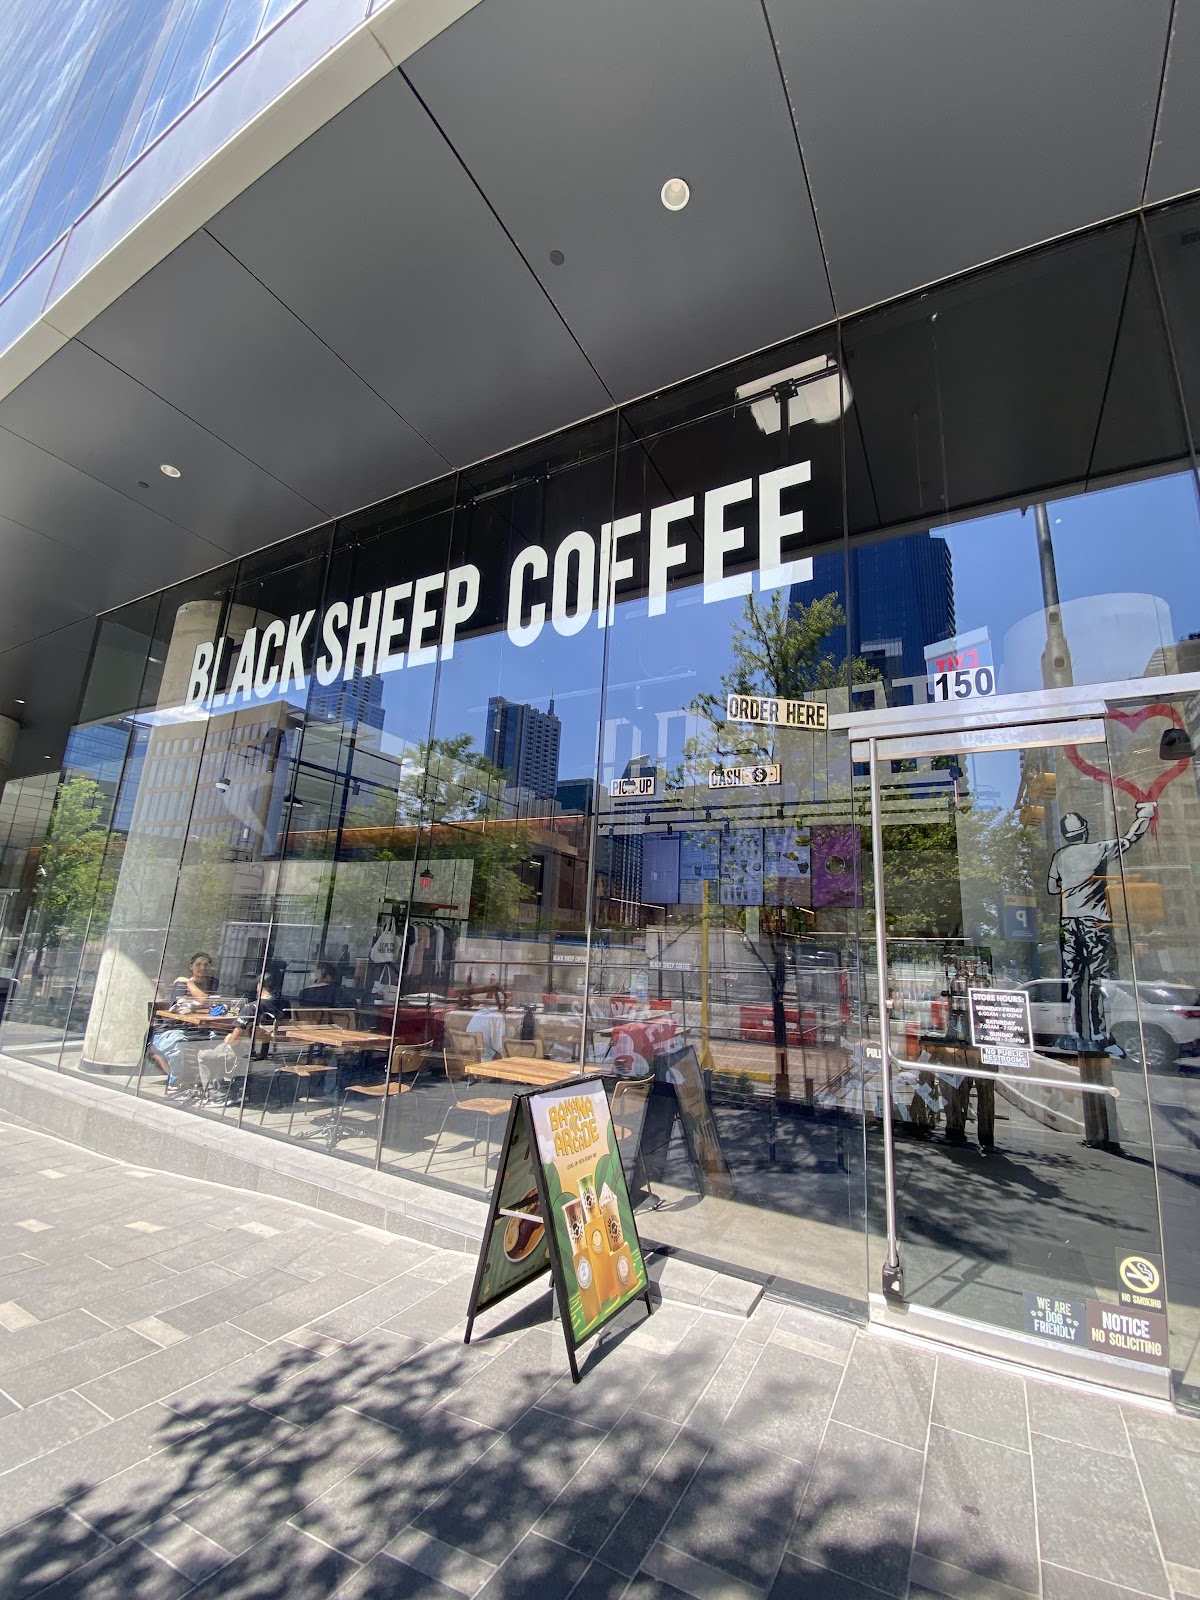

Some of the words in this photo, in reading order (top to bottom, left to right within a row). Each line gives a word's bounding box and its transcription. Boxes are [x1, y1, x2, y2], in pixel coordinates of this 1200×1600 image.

[183, 609, 316, 714] BLACK
[316, 563, 480, 687] SHEEP
[507, 460, 813, 647] COFFEE
[935, 667, 993, 701] 150
[729, 697, 779, 722] ORDER
[786, 702, 826, 727] HERE
[711, 769, 741, 786] CASH
[973, 994, 996, 1002] STORE
[997, 995, 1025, 1003] HOURS:
[983, 1054, 1027, 1064] RESTROOMS
[997, 1049, 1024, 1057] PUBLIC
[549, 1095, 595, 1131] BANANA
[553, 1117, 600, 1157] ARCADE
[1036, 1296, 1051, 1311] WE
[1053, 1300, 1072, 1316] ARE
[1121, 1292, 1131, 1303] NO
[1132, 1295, 1162, 1309] SMOKING
[1045, 1310, 1064, 1325] DOG
[1101, 1311, 1150, 1339] NOTICE
[1034, 1319, 1076, 1341] FRIENDLY
[1091, 1328, 1106, 1343] NO
[1108, 1332, 1162, 1357] SOLICITING
